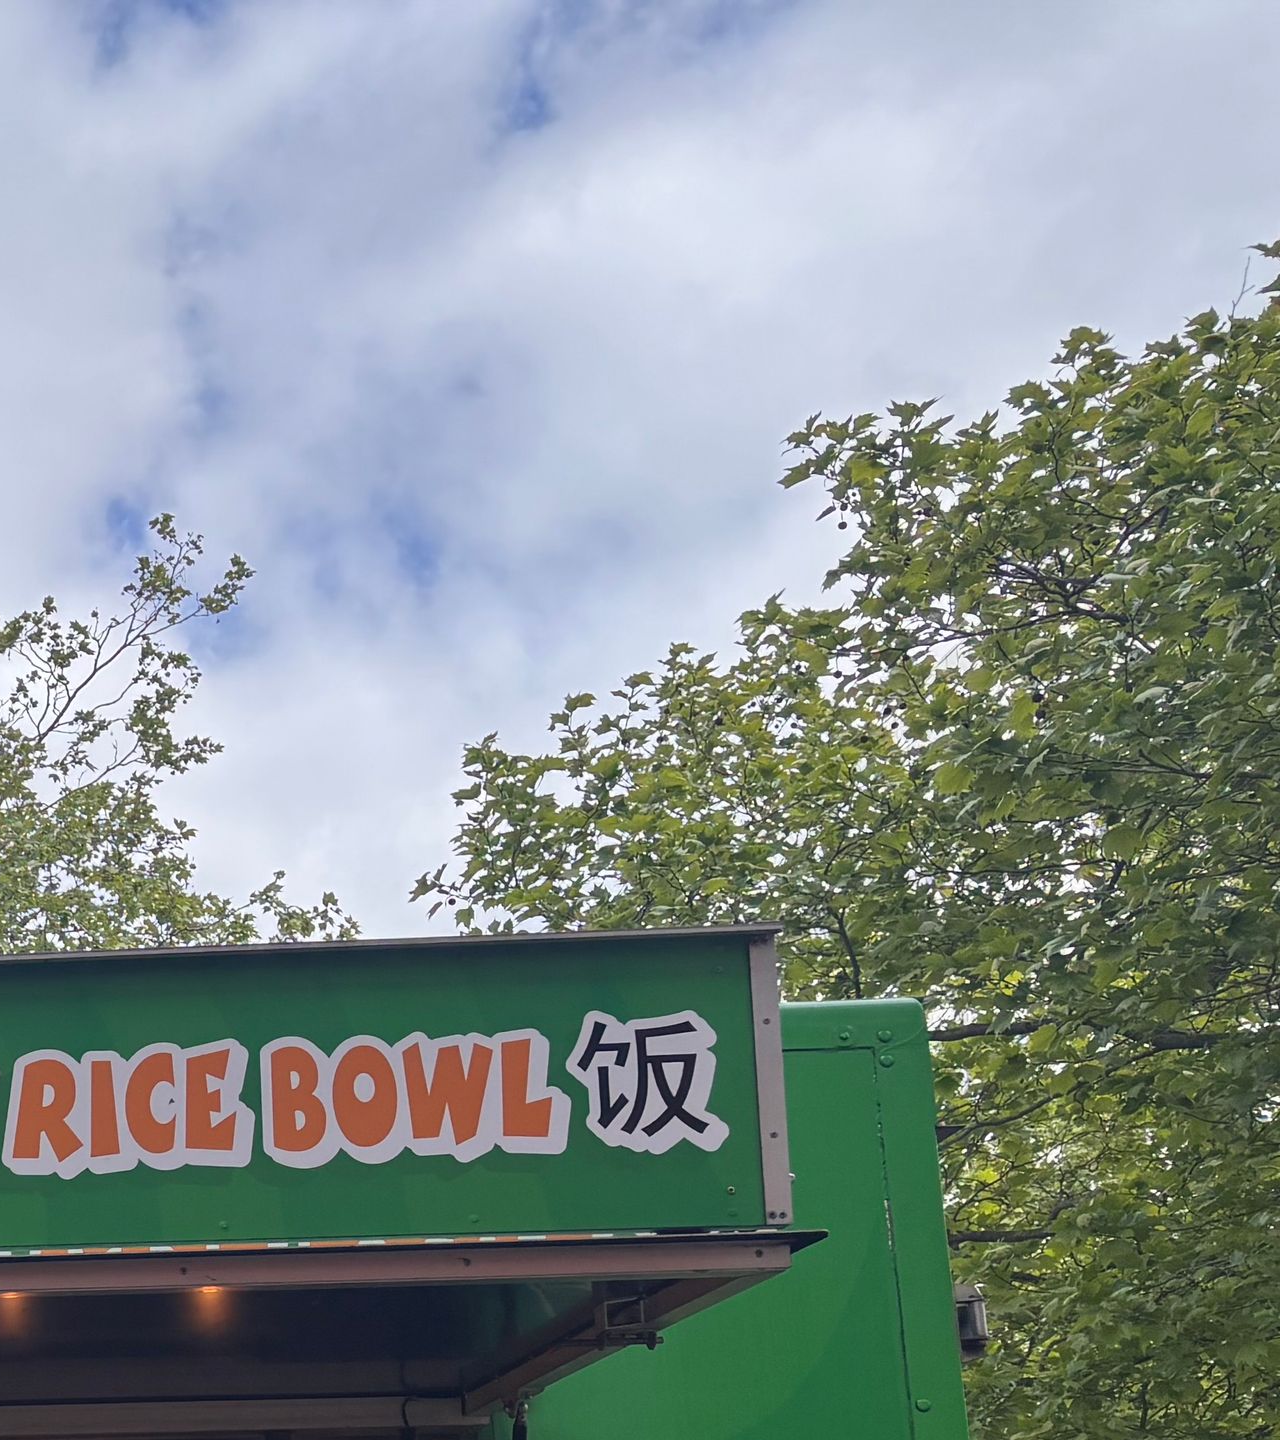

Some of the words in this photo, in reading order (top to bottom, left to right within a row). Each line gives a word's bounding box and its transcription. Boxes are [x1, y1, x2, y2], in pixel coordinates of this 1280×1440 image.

[11, 1047, 241, 1163] RICE
[268, 1036, 558, 1156] BOWL
[575, 1019, 713, 1138] 饭
